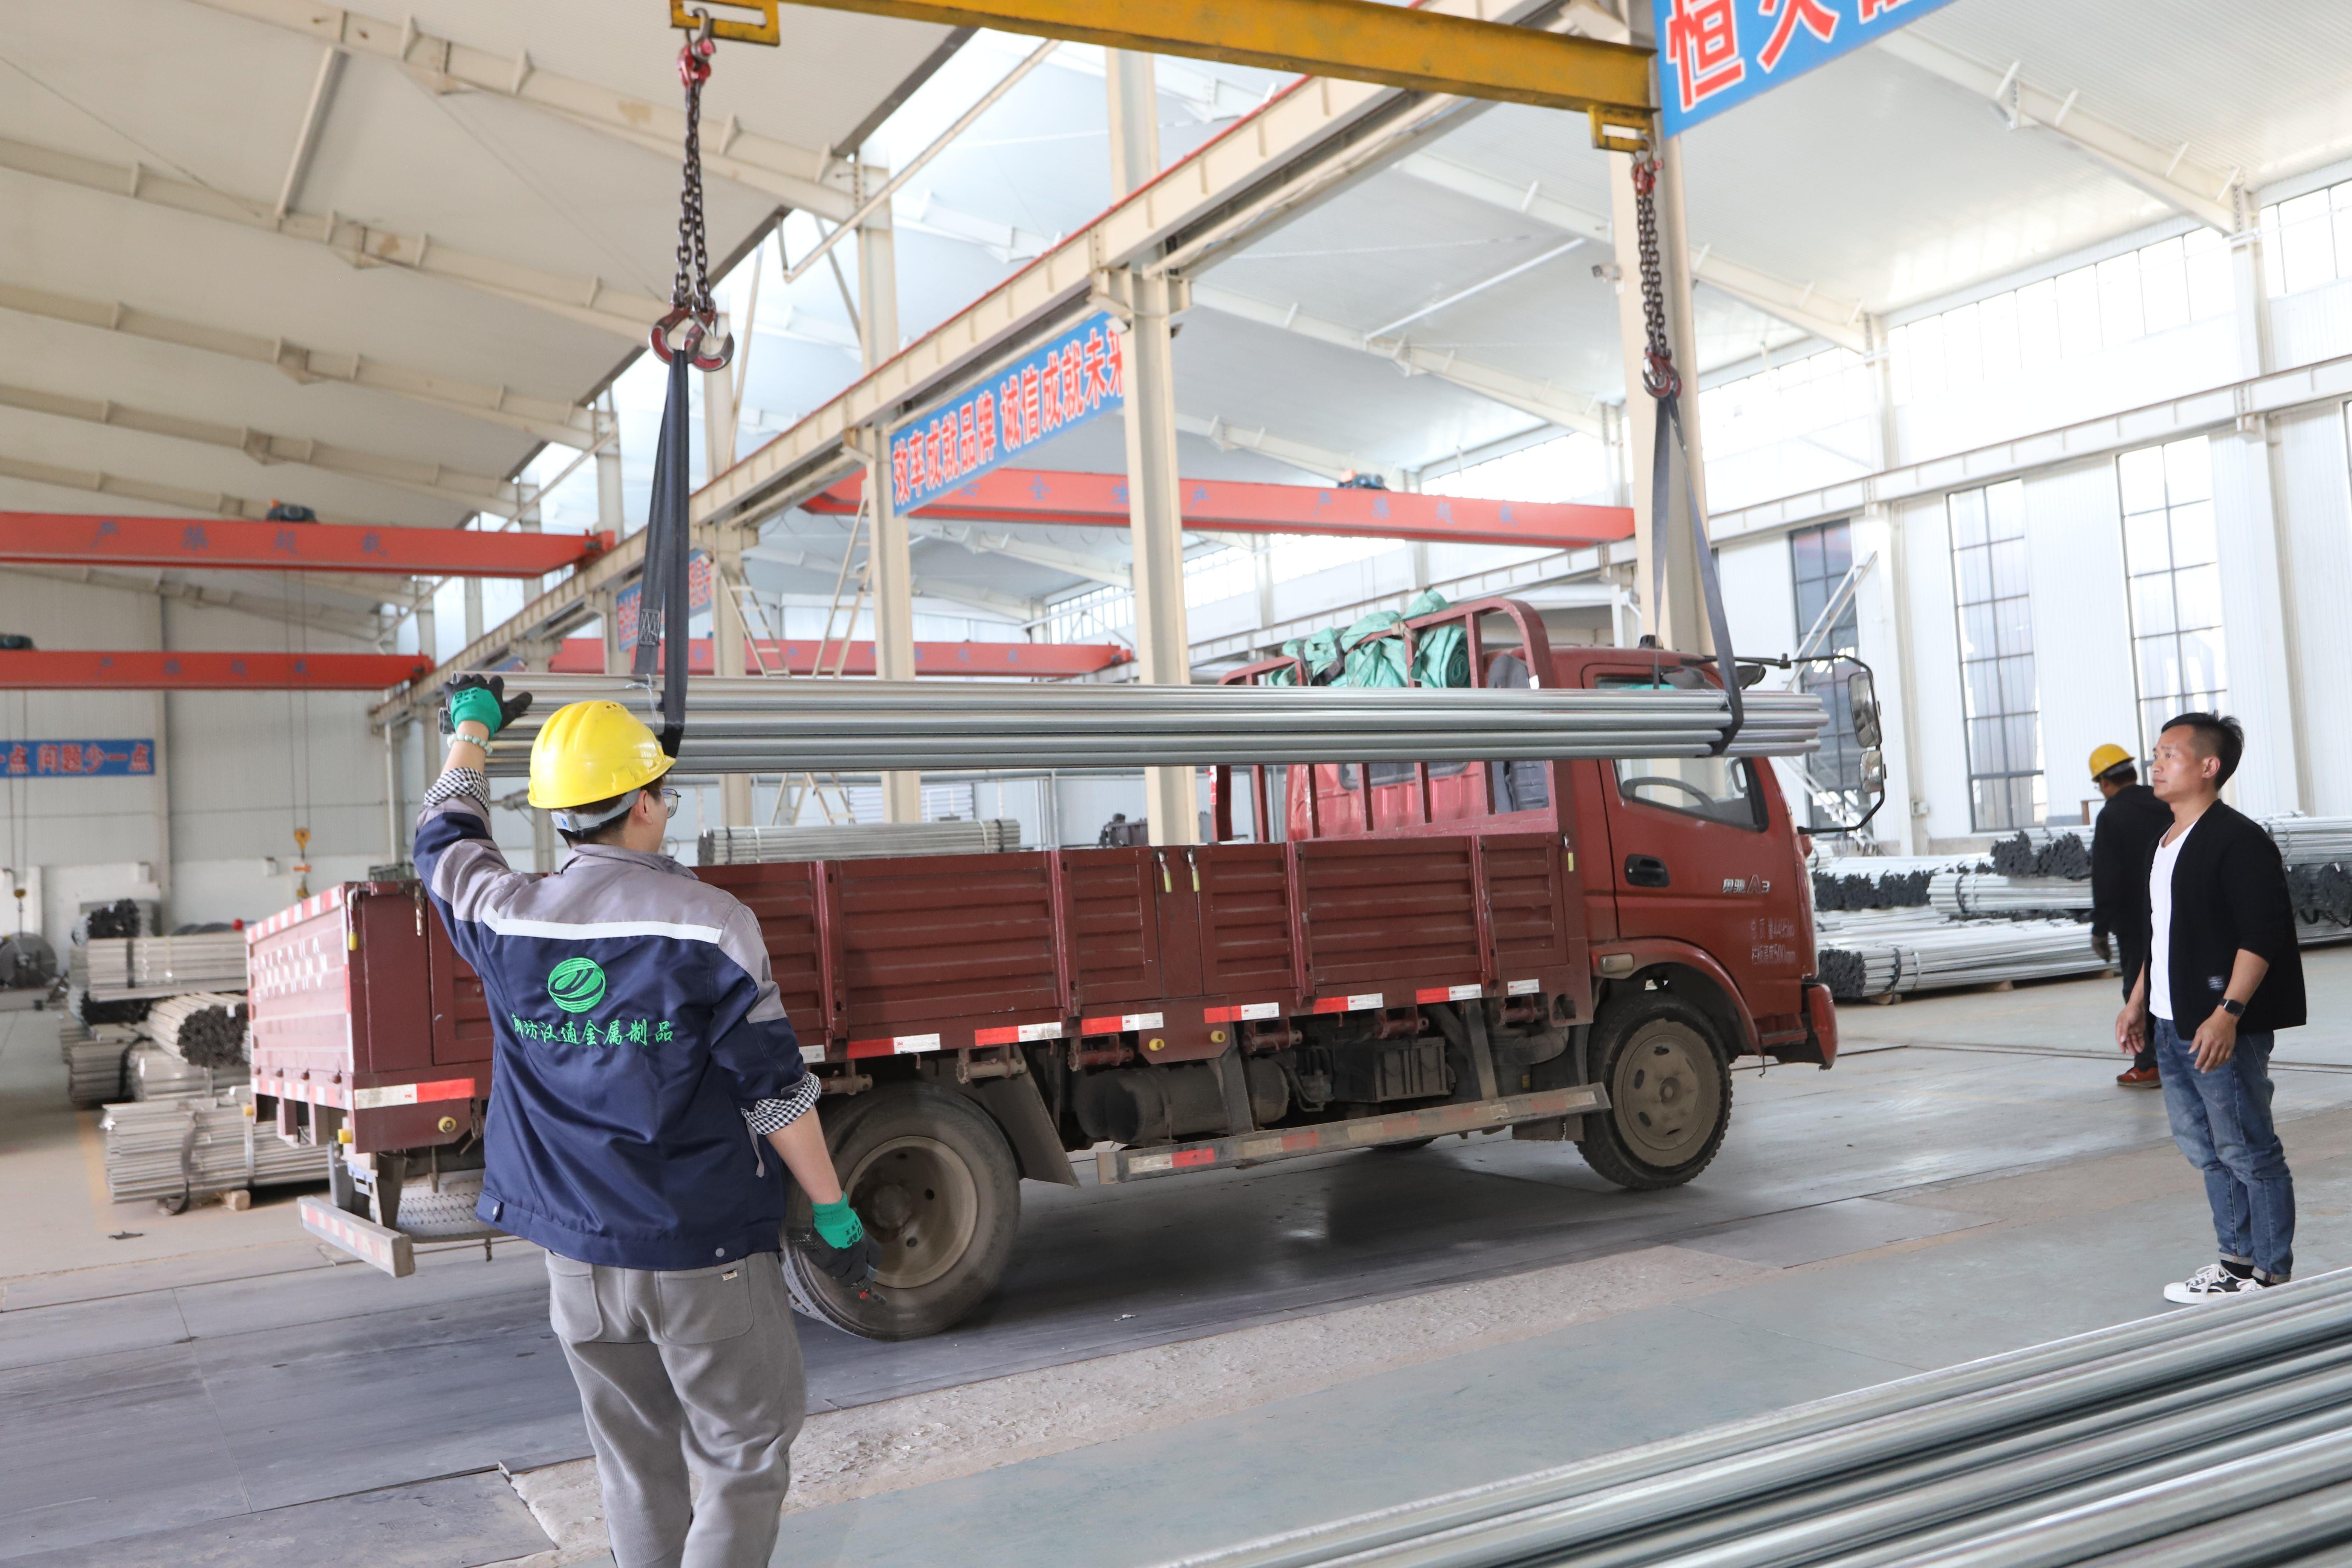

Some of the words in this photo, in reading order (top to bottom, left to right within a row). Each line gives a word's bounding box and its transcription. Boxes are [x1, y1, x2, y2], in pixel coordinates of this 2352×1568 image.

[893, 390, 996, 505] 效率成就品牌
